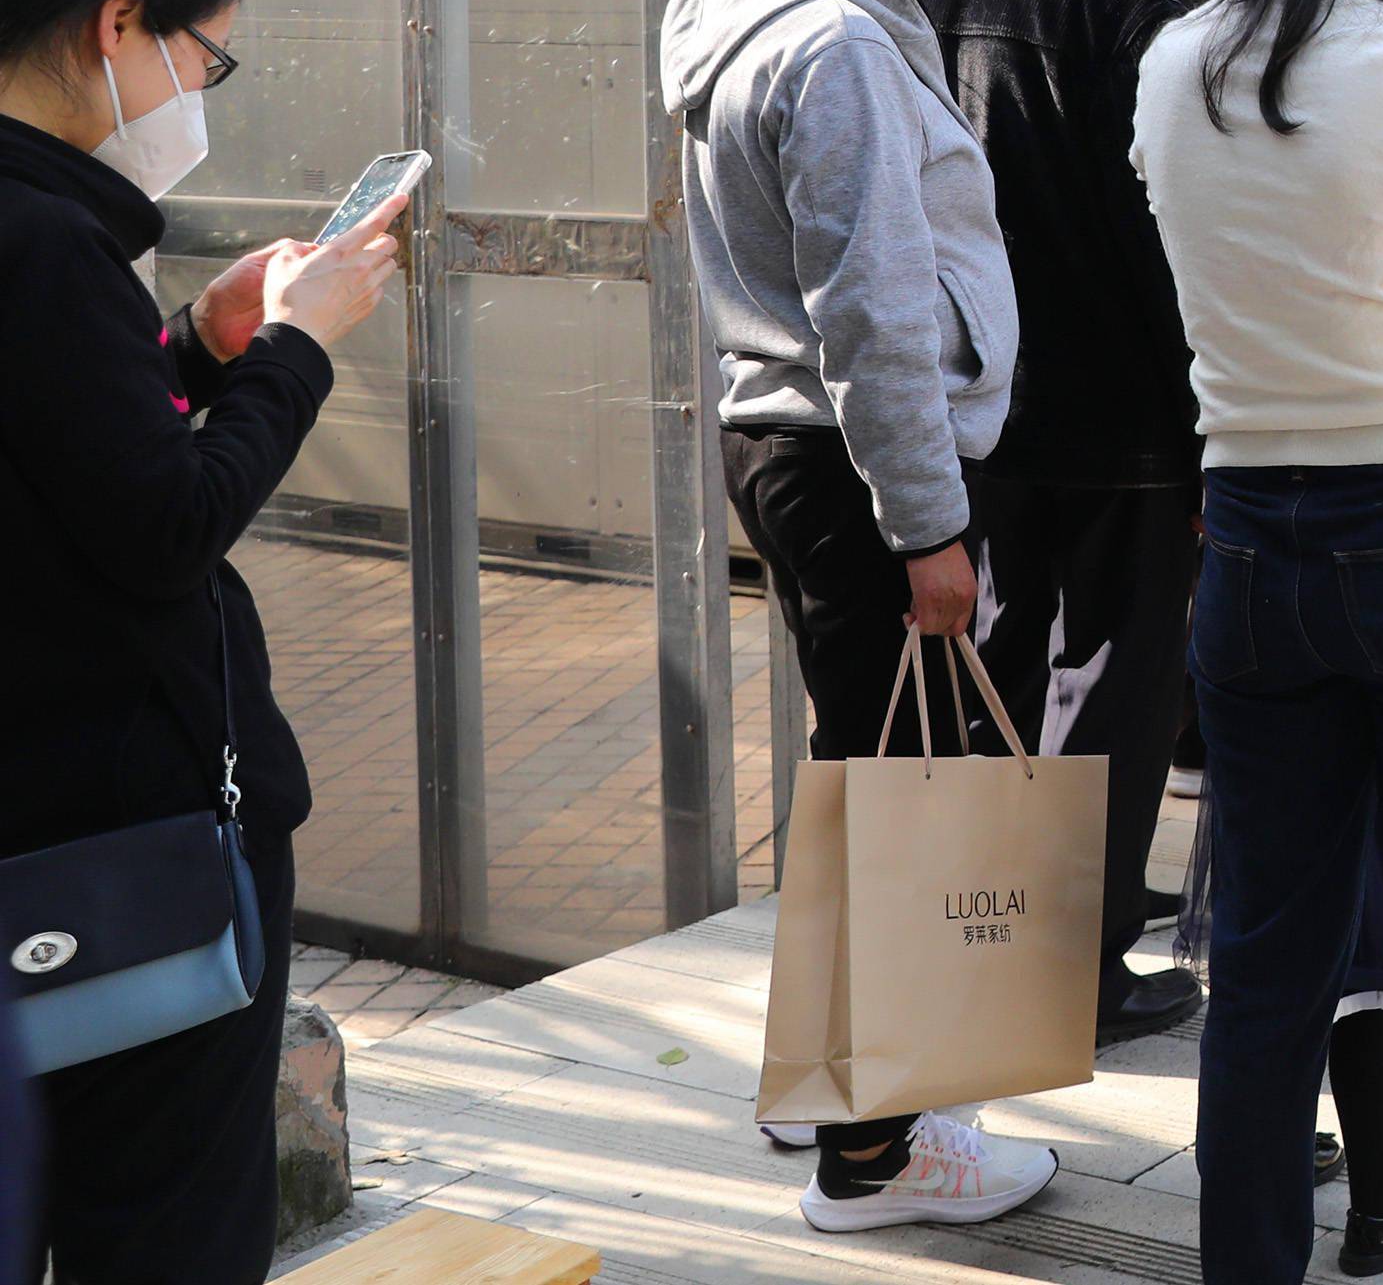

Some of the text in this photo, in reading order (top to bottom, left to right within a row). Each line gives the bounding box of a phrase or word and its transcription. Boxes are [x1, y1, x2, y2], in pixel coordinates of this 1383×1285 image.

[945, 889, 1025, 920] LUOLAI
[962, 923, 1011, 946] 罗莱家纺
